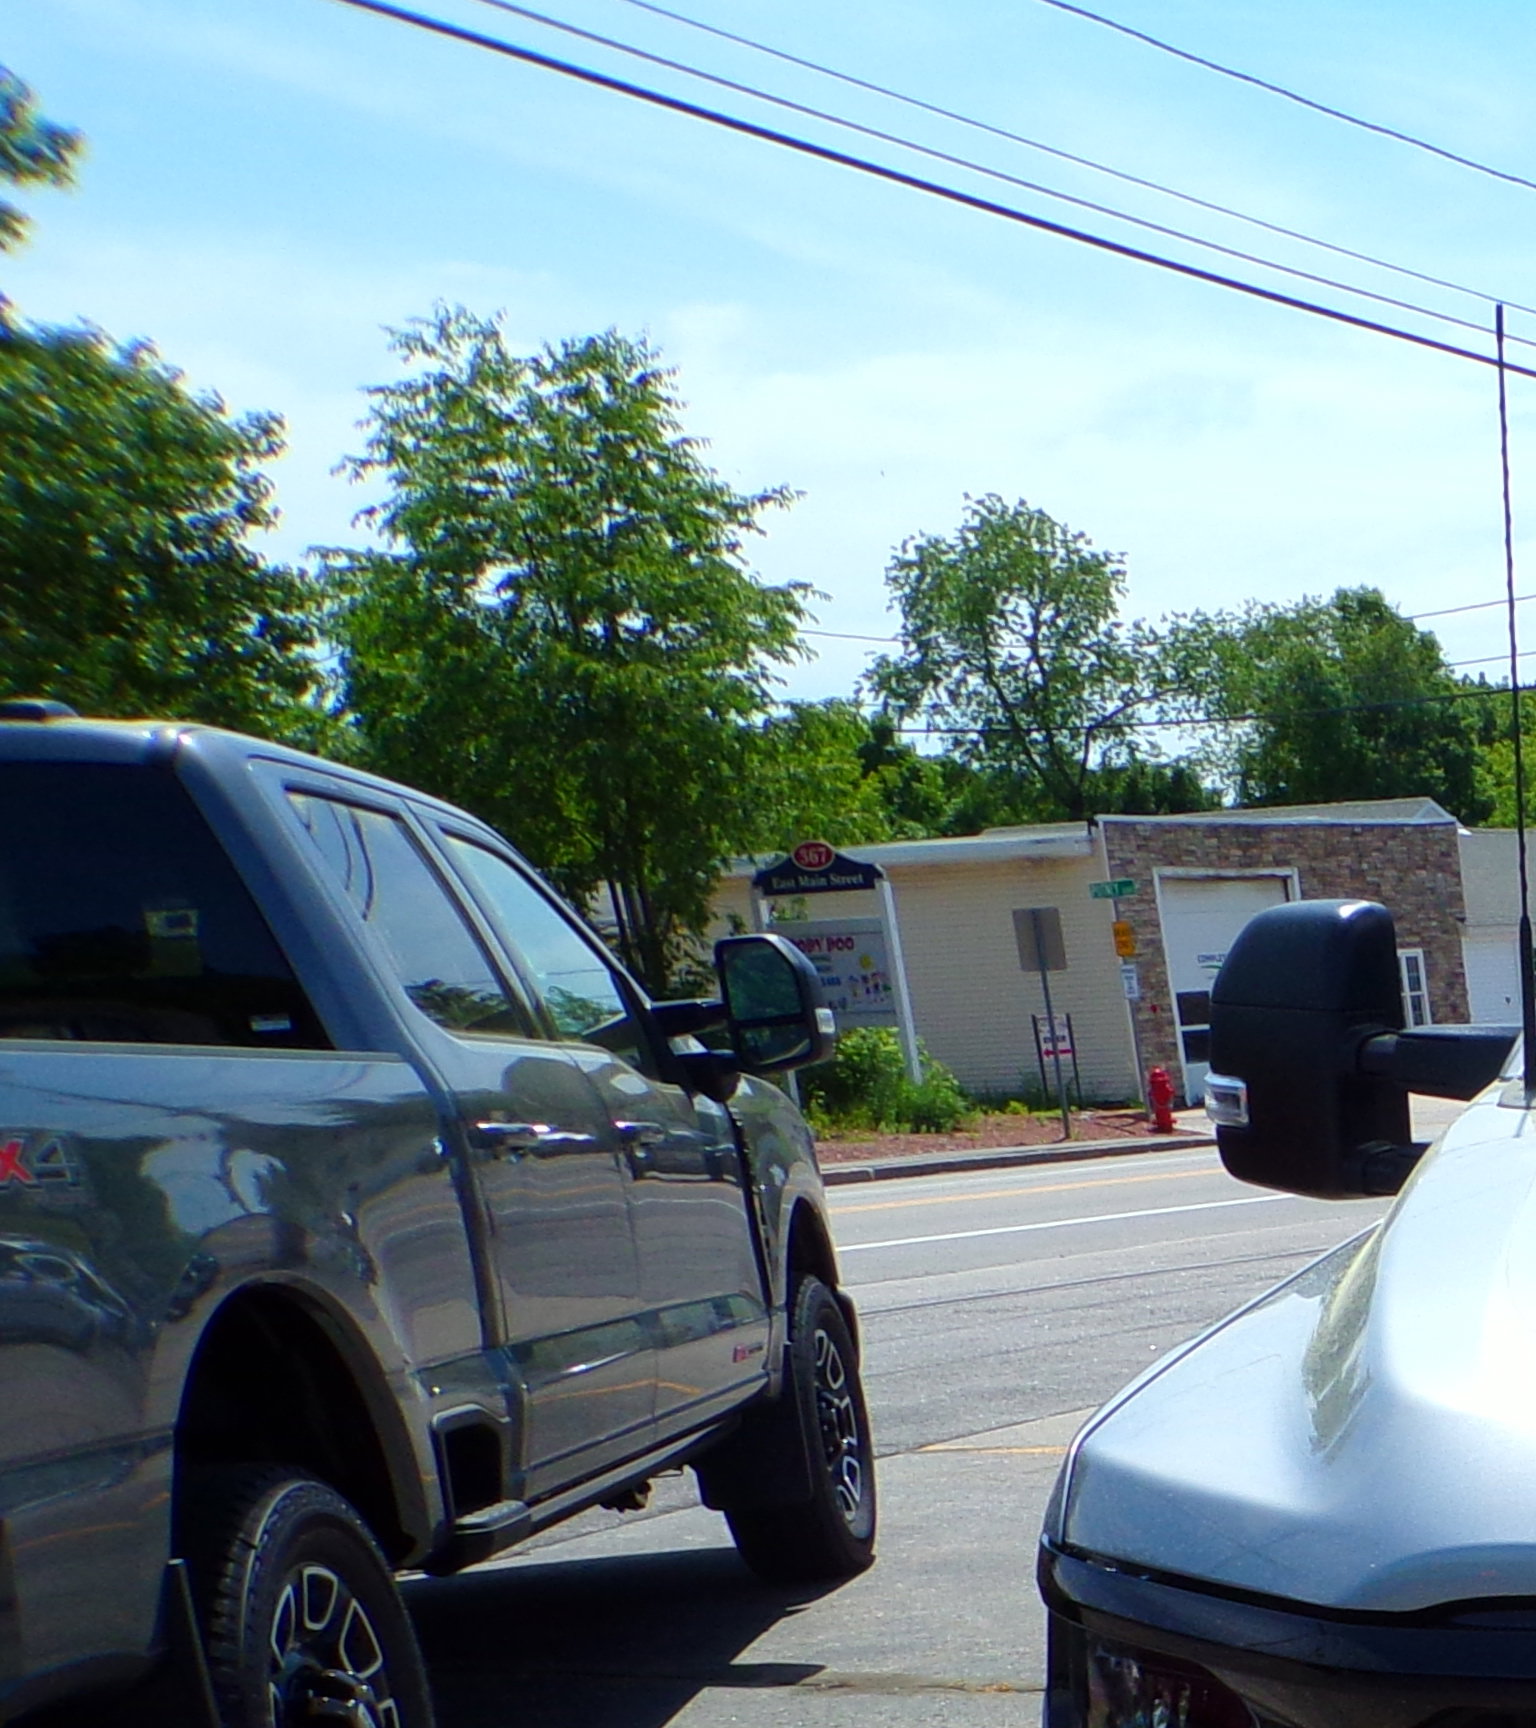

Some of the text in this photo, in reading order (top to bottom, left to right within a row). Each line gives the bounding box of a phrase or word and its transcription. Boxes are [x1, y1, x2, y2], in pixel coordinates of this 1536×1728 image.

[798, 846, 827, 865] 367
[771, 872, 864, 889] East Main Street
